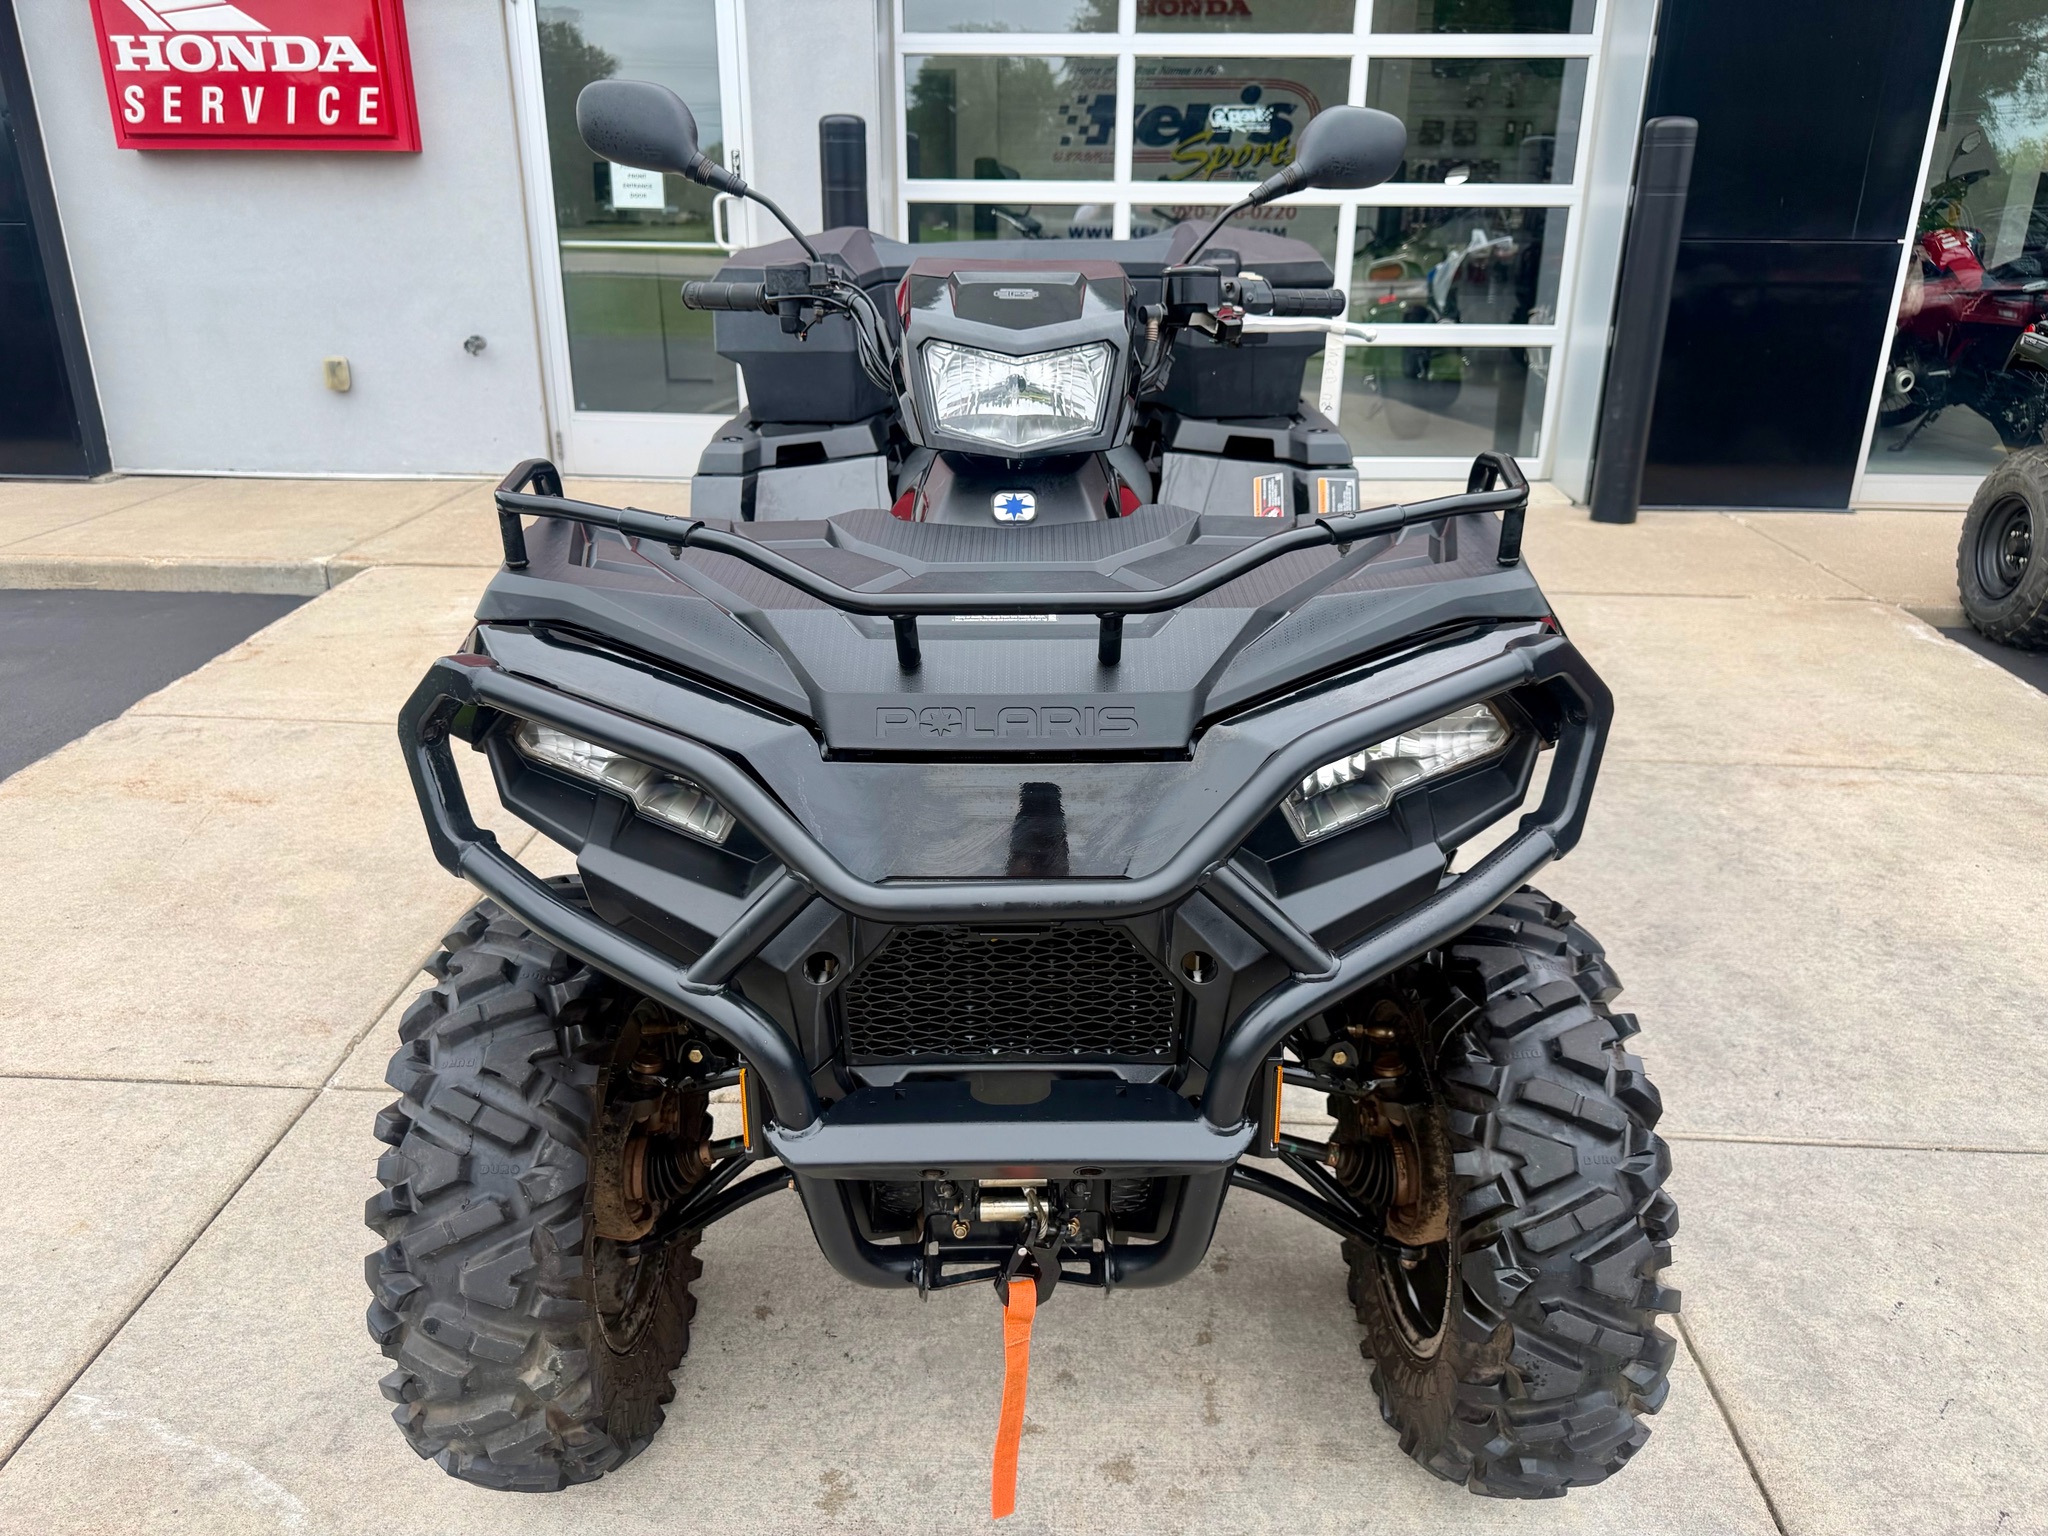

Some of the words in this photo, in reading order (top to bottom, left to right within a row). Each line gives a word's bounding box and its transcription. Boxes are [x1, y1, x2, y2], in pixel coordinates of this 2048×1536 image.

[109, 34, 377, 73] HONDA
[123, 85, 380, 125] SERVICE
[876, 706, 1139, 738] POLARIS
[480, 1164, 520, 1174] DURO
